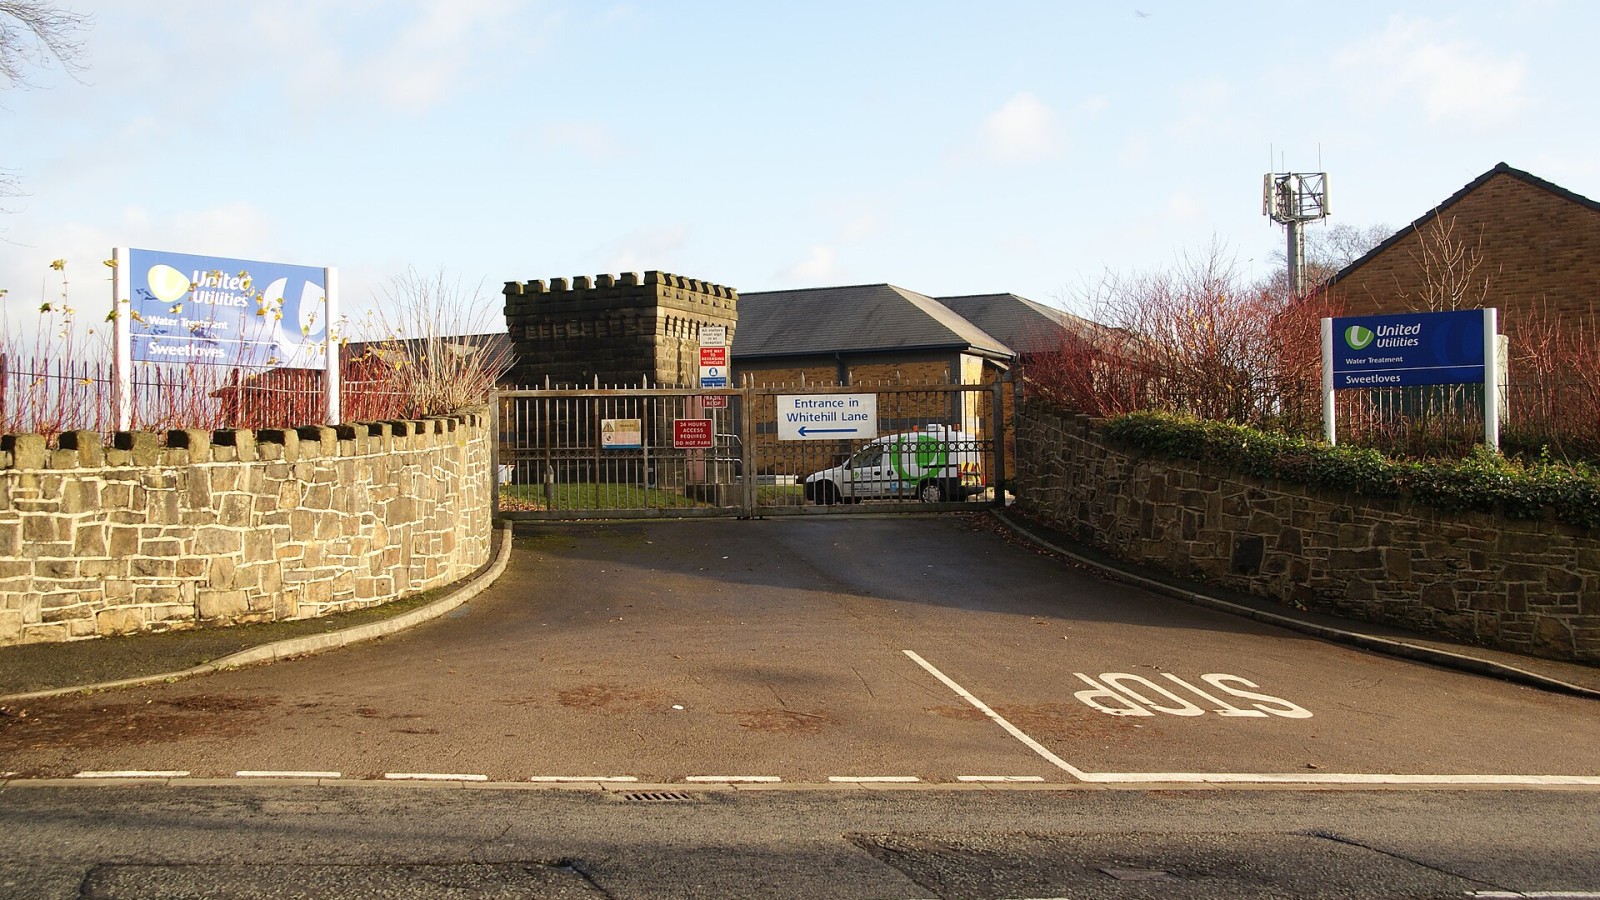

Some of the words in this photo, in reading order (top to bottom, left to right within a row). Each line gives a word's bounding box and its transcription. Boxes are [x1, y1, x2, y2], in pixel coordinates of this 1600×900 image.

[192, 269, 252, 291] United
[192, 290, 249, 308] Utilities
[148, 315, 179, 327] Water
[1376, 323, 1421, 337] United
[1376, 336, 1419, 348] Utilities
[148, 341, 226, 358] Sweetloves
[1345, 357, 1366, 365] Water
[1368, 356, 1403, 364] Treatment
[1345, 374, 1400, 384] Sweetloves
[794, 398, 844, 408] Entrance
[848, 397, 859, 407] in
[786, 411, 837, 422] Whitehill
[841, 412, 868, 421] Lane
[1072, 672, 1313, 718] STOP
